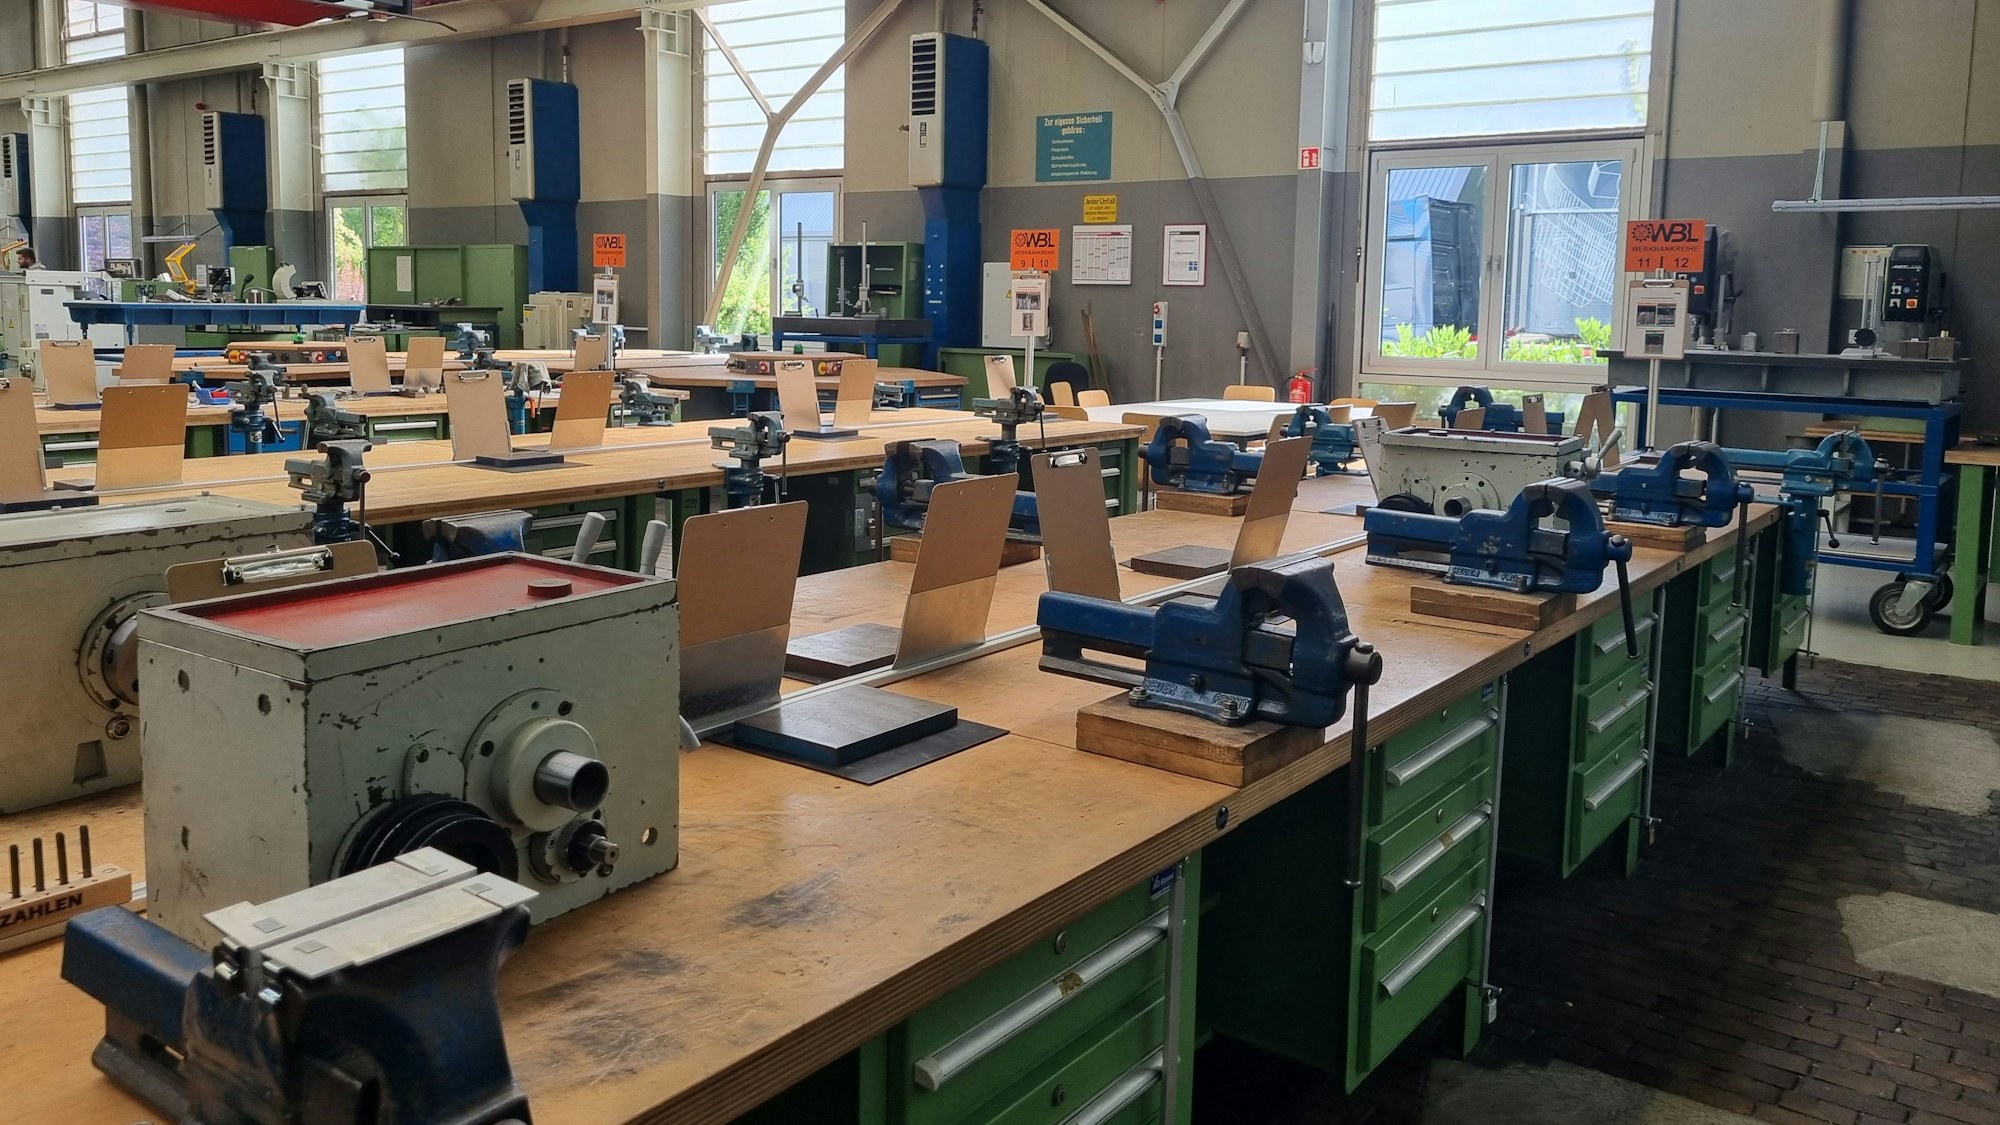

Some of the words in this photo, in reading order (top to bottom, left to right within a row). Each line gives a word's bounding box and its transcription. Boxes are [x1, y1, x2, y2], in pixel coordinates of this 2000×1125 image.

[1044, 117, 1053, 127] Zur
[1075, 115, 1103, 125] Sicherheit
[1650, 223, 1698, 242] WBL
[603, 236, 623, 249] WBL
[1025, 232, 1055, 248] WBL
[1631, 245, 1699, 253] WERKBANKREIHE
[1039, 259, 1049, 268] 10
[1637, 258, 1650, 268] 11
[1674, 258, 1689, 268] 12
[0, 893, 83, 927] ZAHLEN
